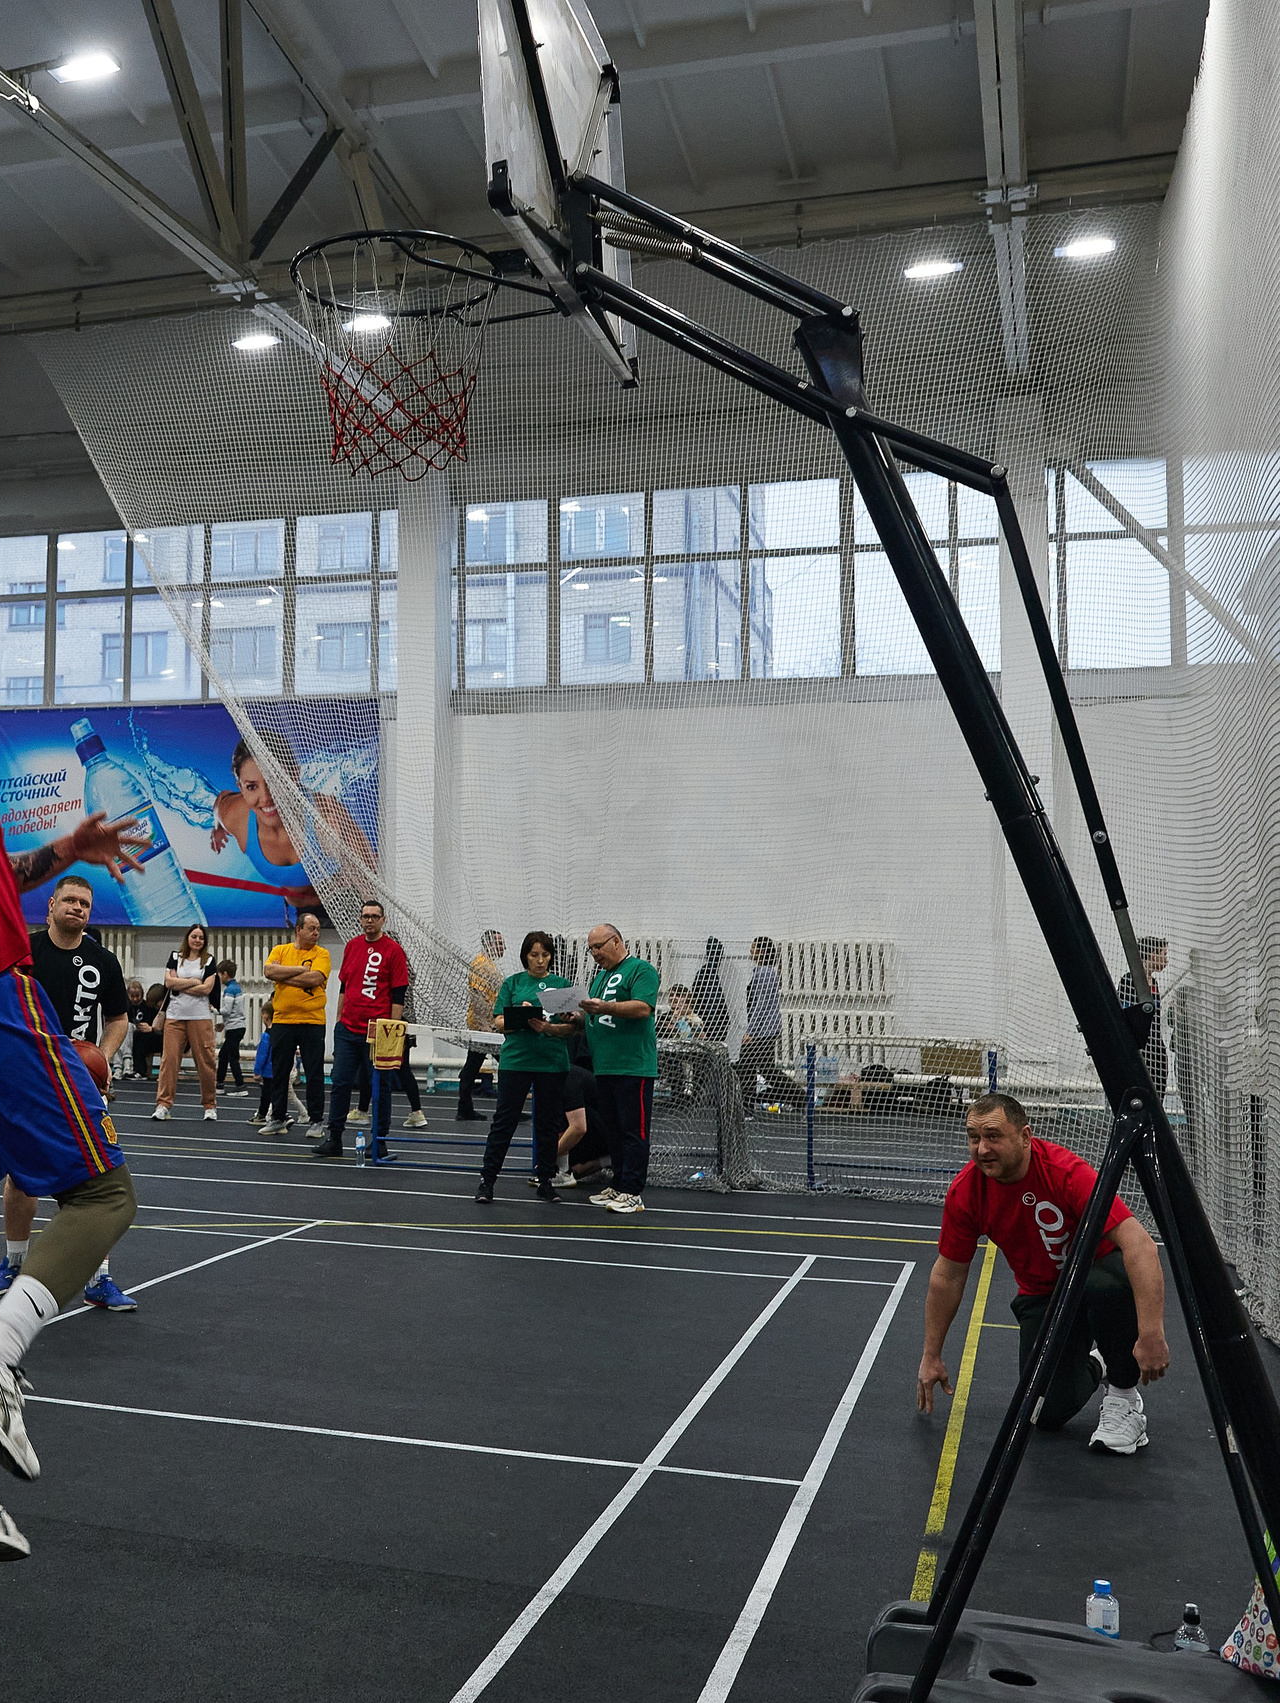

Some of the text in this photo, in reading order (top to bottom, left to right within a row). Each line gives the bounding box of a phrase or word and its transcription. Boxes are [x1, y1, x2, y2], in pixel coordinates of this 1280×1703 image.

[1, 798, 82, 824] вдохновляет
[8, 815, 57, 837] победы!
[599, 973, 623, 1029] АТО
